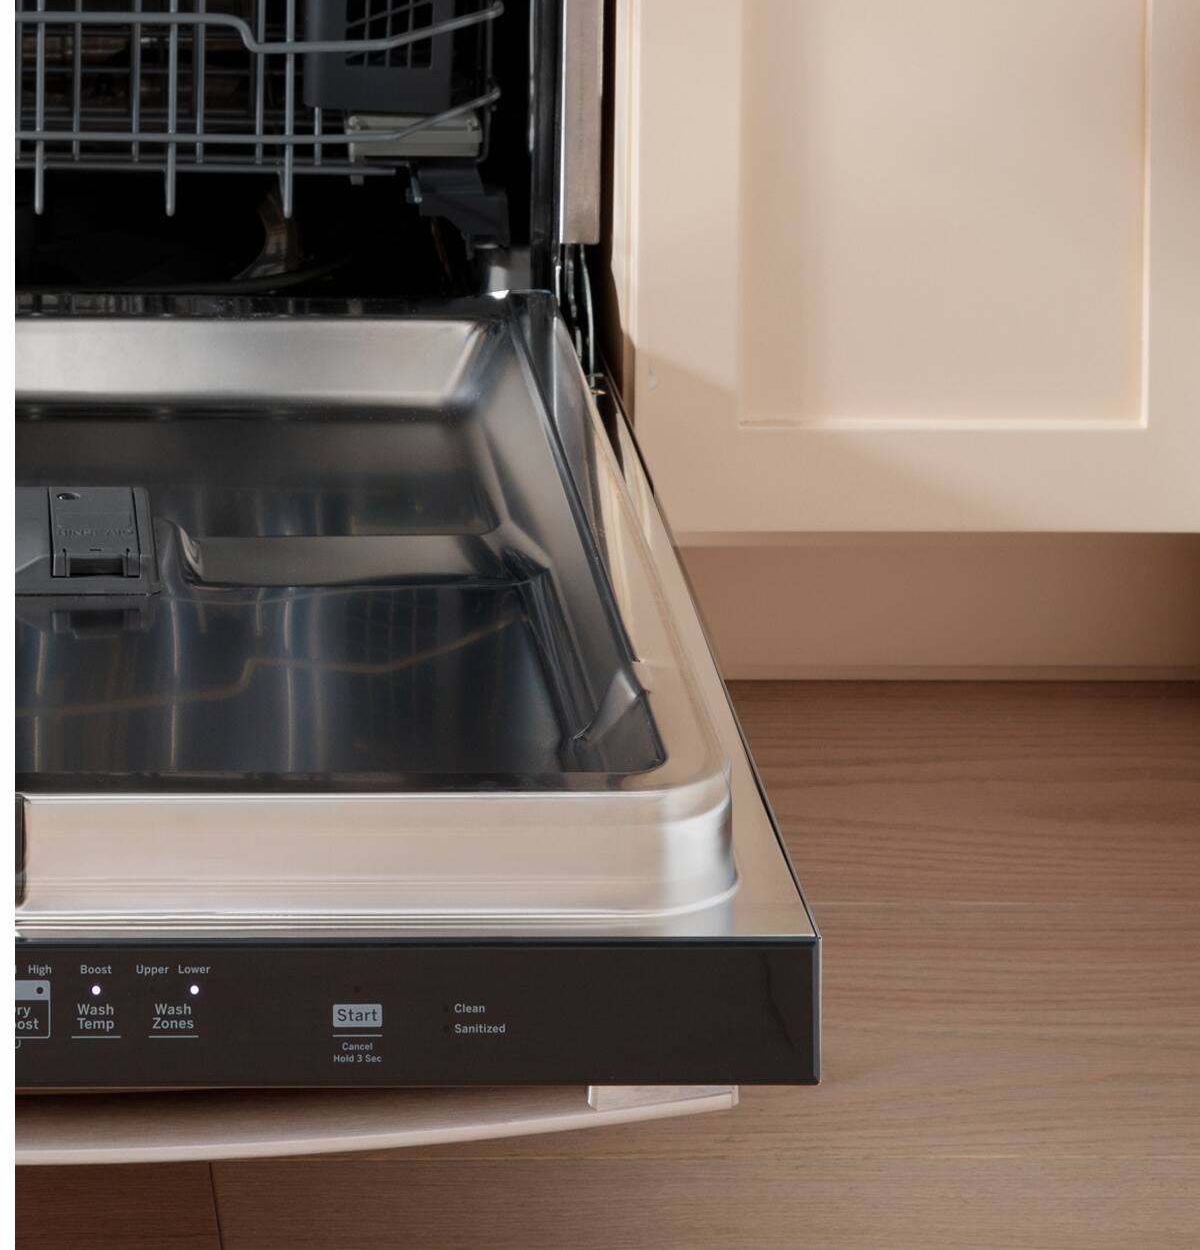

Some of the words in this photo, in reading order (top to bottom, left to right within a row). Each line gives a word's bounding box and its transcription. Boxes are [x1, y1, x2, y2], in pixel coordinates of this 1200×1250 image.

[28, 964, 52, 977] High
[80, 964, 112, 975] Boost
[136, 964, 169, 977] Upper
[178, 964, 211, 975] Lower
[15, 1006, 31, 1018] ry
[77, 1003, 115, 1016] Wash
[154, 1003, 192, 1016] Wash
[454, 1003, 486, 1014] Clean
[336, 1008, 378, 1023] Start
[77, 1017, 115, 1032] Temp
[152, 1016, 194, 1030] Zones
[454, 1023, 506, 1034] Sanitized
[341, 1042, 373, 1051] Cancel
[333, 1053, 355, 1063] Hold
[356, 1054, 363, 1063] 3
[365, 1053, 382, 1063] Sec
